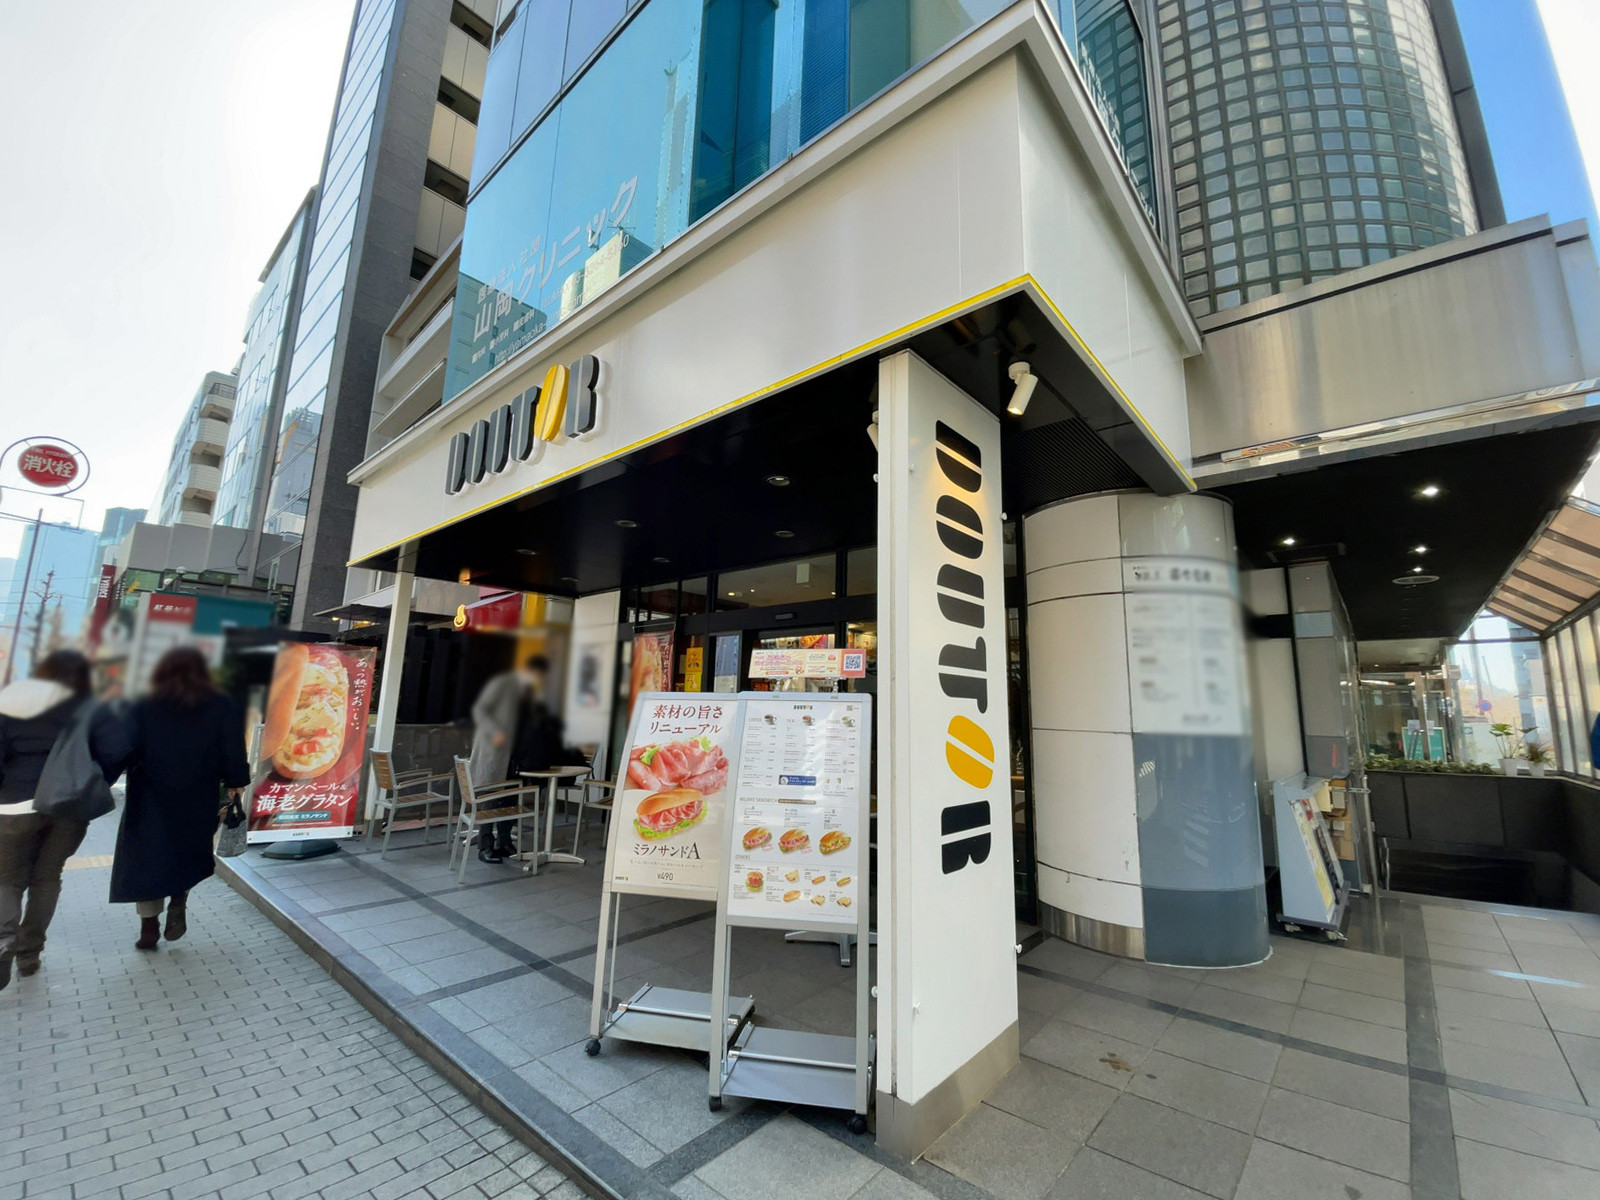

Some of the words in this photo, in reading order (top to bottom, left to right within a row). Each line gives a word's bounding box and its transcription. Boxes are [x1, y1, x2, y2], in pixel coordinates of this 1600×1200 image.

[473, 176, 638, 342] 山岡クリニック
[445, 354, 600, 495] DOUTOR
[23, 453, 74, 478] 消火栓
[935, 419, 995, 875] DOUTOR
[652, 704, 723, 719] 素材の旨さ
[650, 721, 722, 735] リニューアル
[256, 793, 353, 812] 海老グラタン
[633, 842, 701, 860] ミラノサンドA
